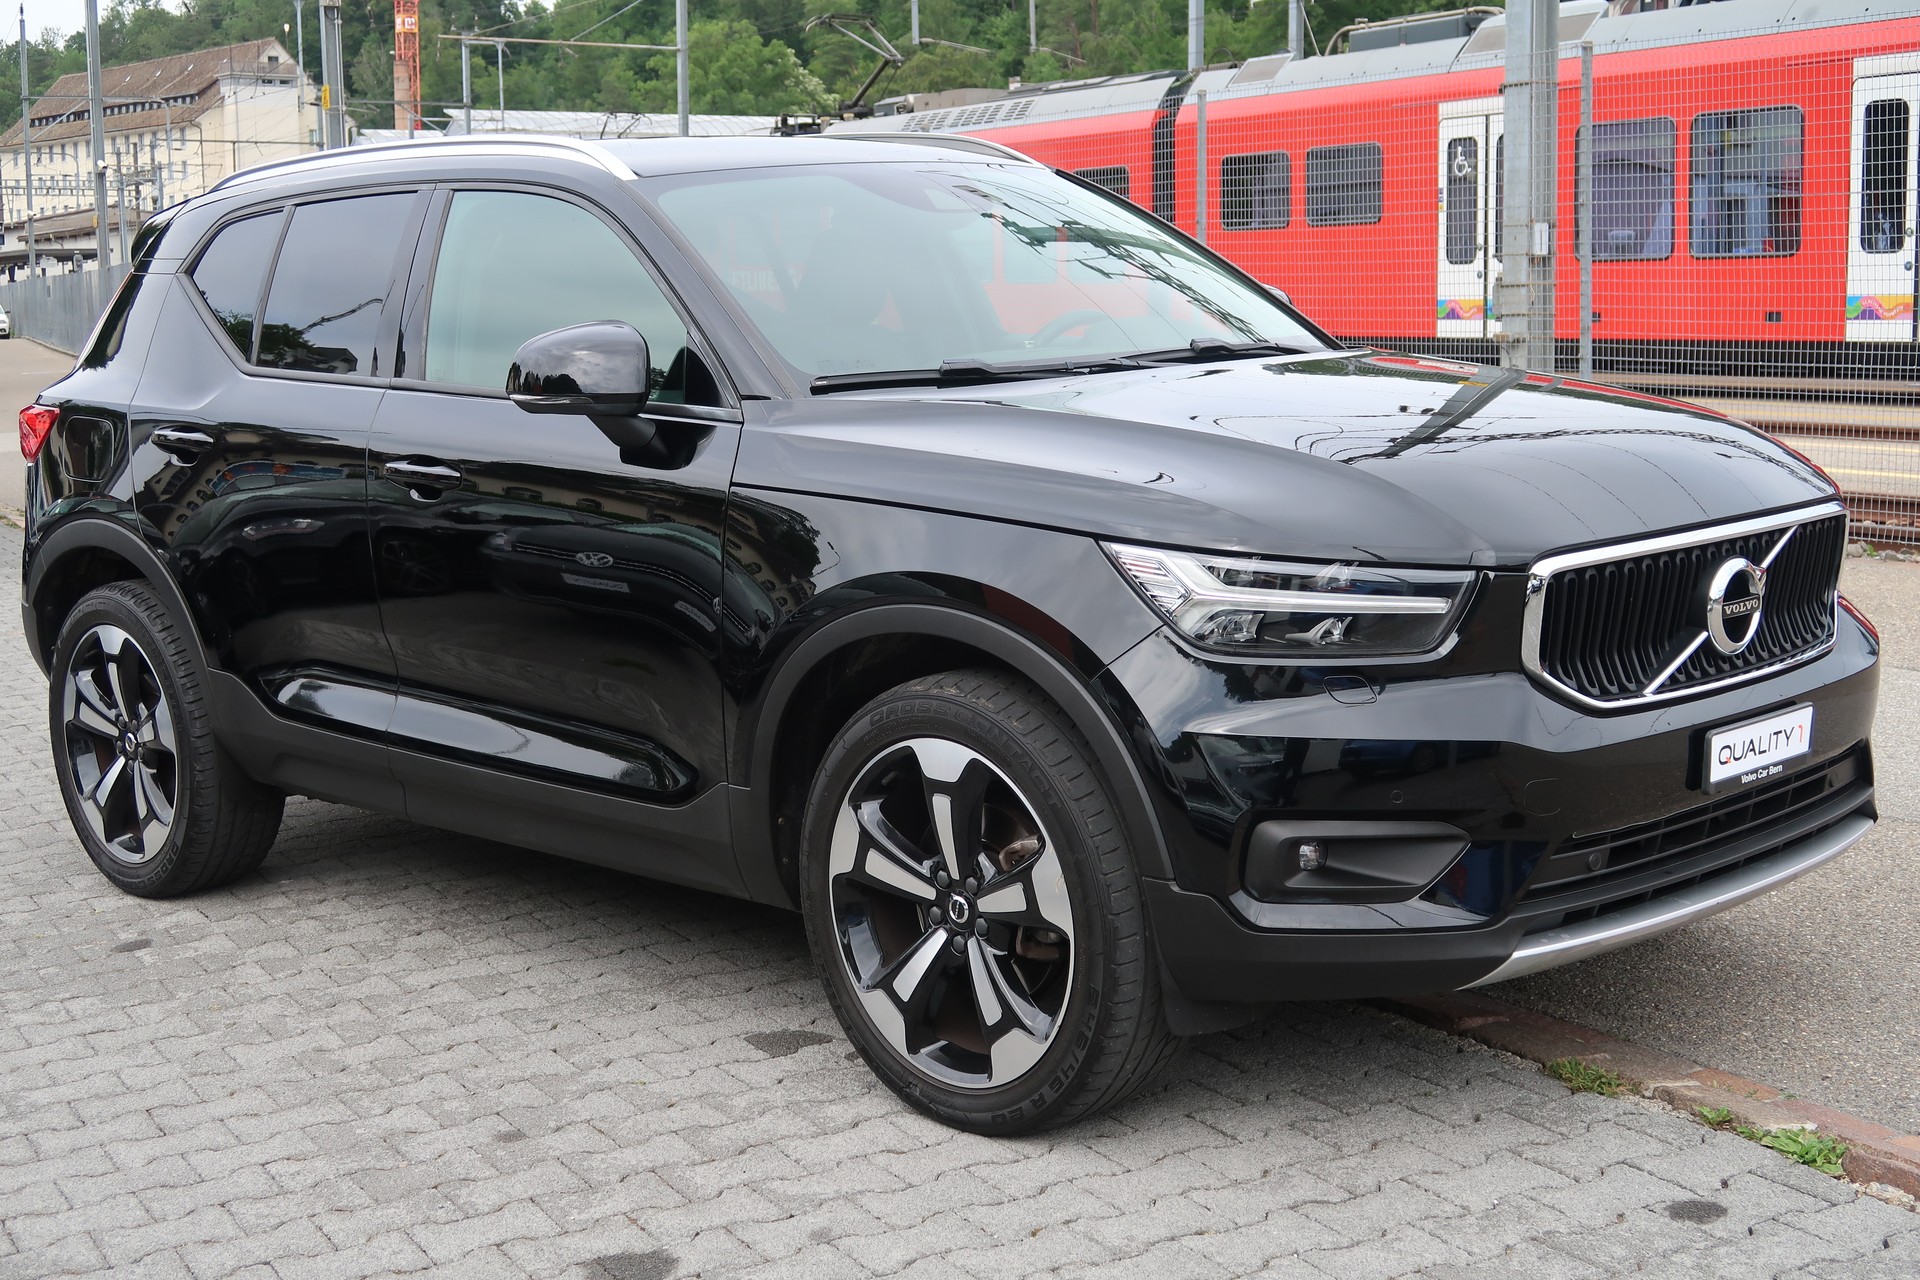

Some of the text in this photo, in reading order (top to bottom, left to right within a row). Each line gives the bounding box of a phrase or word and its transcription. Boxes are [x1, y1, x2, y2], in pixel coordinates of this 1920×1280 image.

[1724, 599, 1759, 615] VOLVO
[1718, 724, 1804, 766] QUALITY 1
[1741, 764, 1783, 784] Volvo Car Bern
